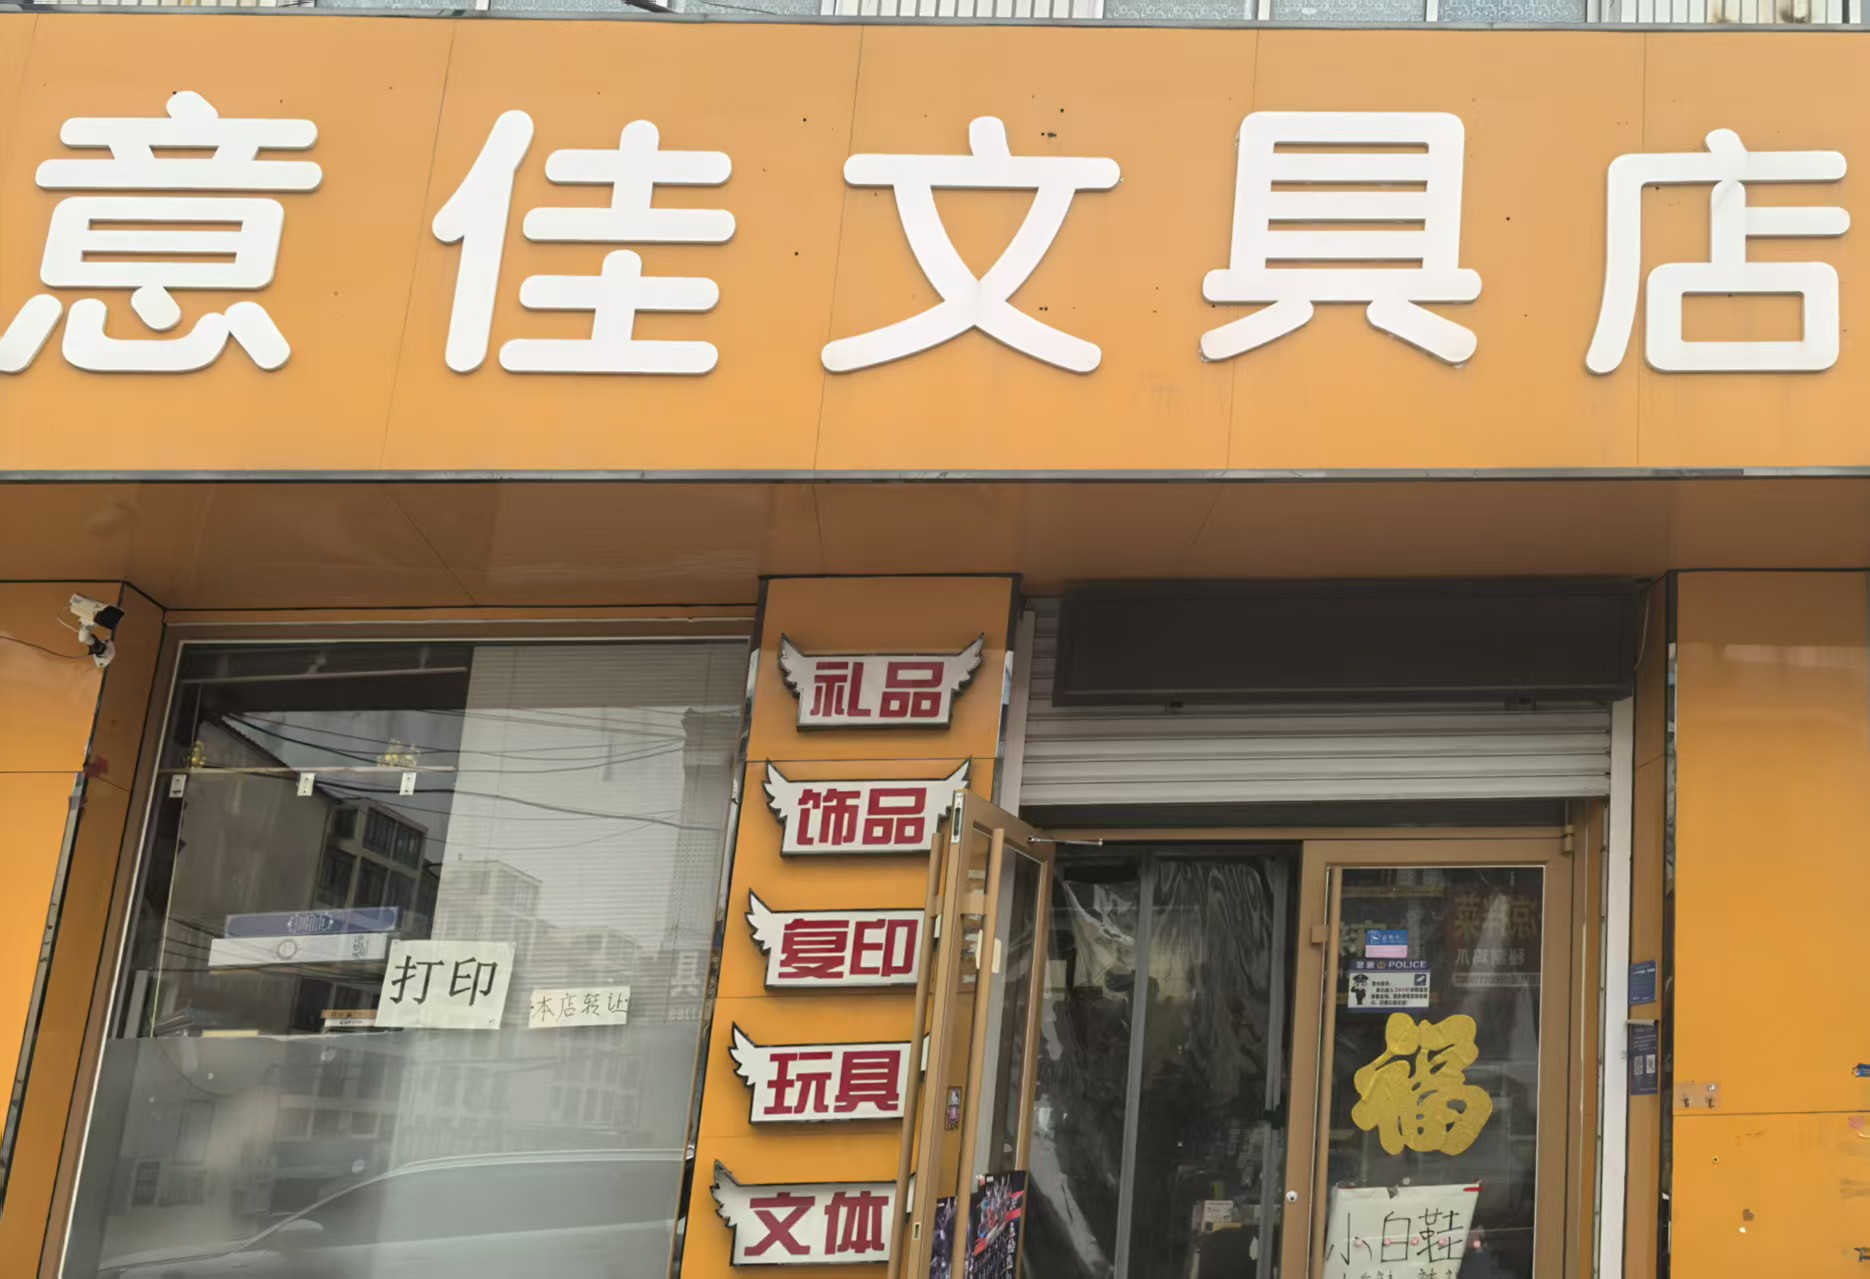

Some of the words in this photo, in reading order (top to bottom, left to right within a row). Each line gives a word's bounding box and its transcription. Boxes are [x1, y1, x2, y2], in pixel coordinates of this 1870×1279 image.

[0, 91, 1850, 374] 意佳文具店
[811, 661, 944, 718] 礼品
[797, 787, 927, 846] 饰品
[779, 918, 919, 979] 复印
[1388, 960, 1427, 969] POLICE
[389, 954, 498, 1007] 打印
[532, 991, 628, 1022] 本店转让
[764, 1050, 901, 1115] 玩具
[1352, 1012, 1494, 1156] 福
[745, 1191, 889, 1257] 文体
[1325, 1207, 1465, 1266] 小白鞋
